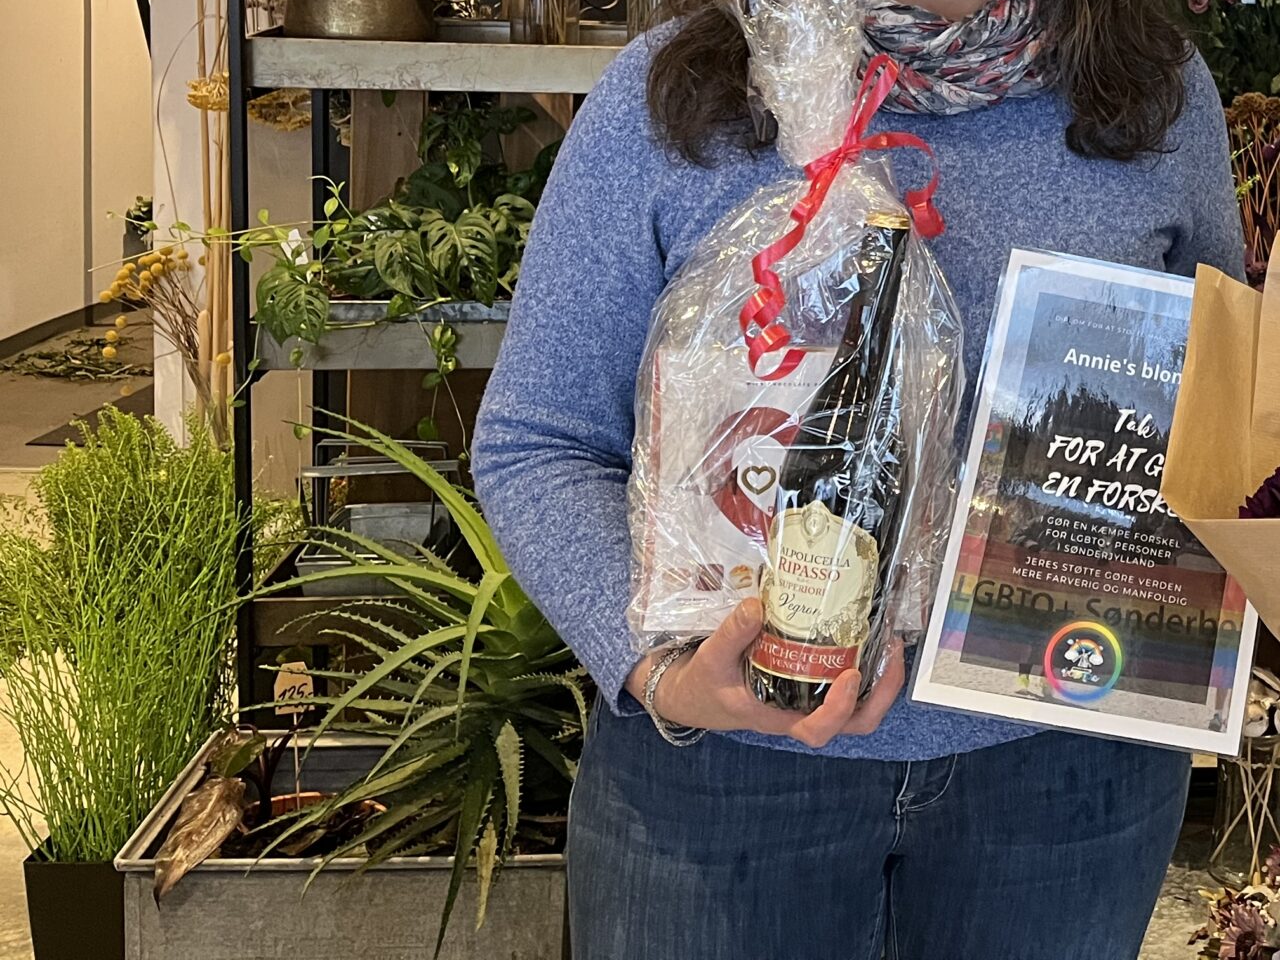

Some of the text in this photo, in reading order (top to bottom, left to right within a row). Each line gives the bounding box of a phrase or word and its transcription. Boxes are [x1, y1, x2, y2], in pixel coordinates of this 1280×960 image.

[1064, 348, 1136, 377] Annie's
[1114, 407, 1157, 440] Tak
[1046, 434, 1105, 467] FOR
[1106, 443, 1148, 473] AT
[1041, 471, 1082, 498] EN
[1045, 528, 1067, 540] FOR
[1114, 541, 1173, 560] PERSONER
[1047, 516, 1071, 528] GØR
[1073, 520, 1089, 531] EN
[1091, 523, 1131, 540] KÆMPE
[1133, 532, 1182, 549] FORSKEL
[778, 556, 841, 583] RIPASSO
[779, 545, 851, 569] ALPOLICELLA
[1064, 544, 1155, 568] SØNDERJYLLAND
[1012, 567, 1188, 607] MERE FARVERIG OG MANFOLDIG
[1025, 556, 1183, 593] JERES STØTTE GØRE VERDEN
[1085, 597, 1243, 638] Sønderbo
[799, 652, 846, 670] TERRE
